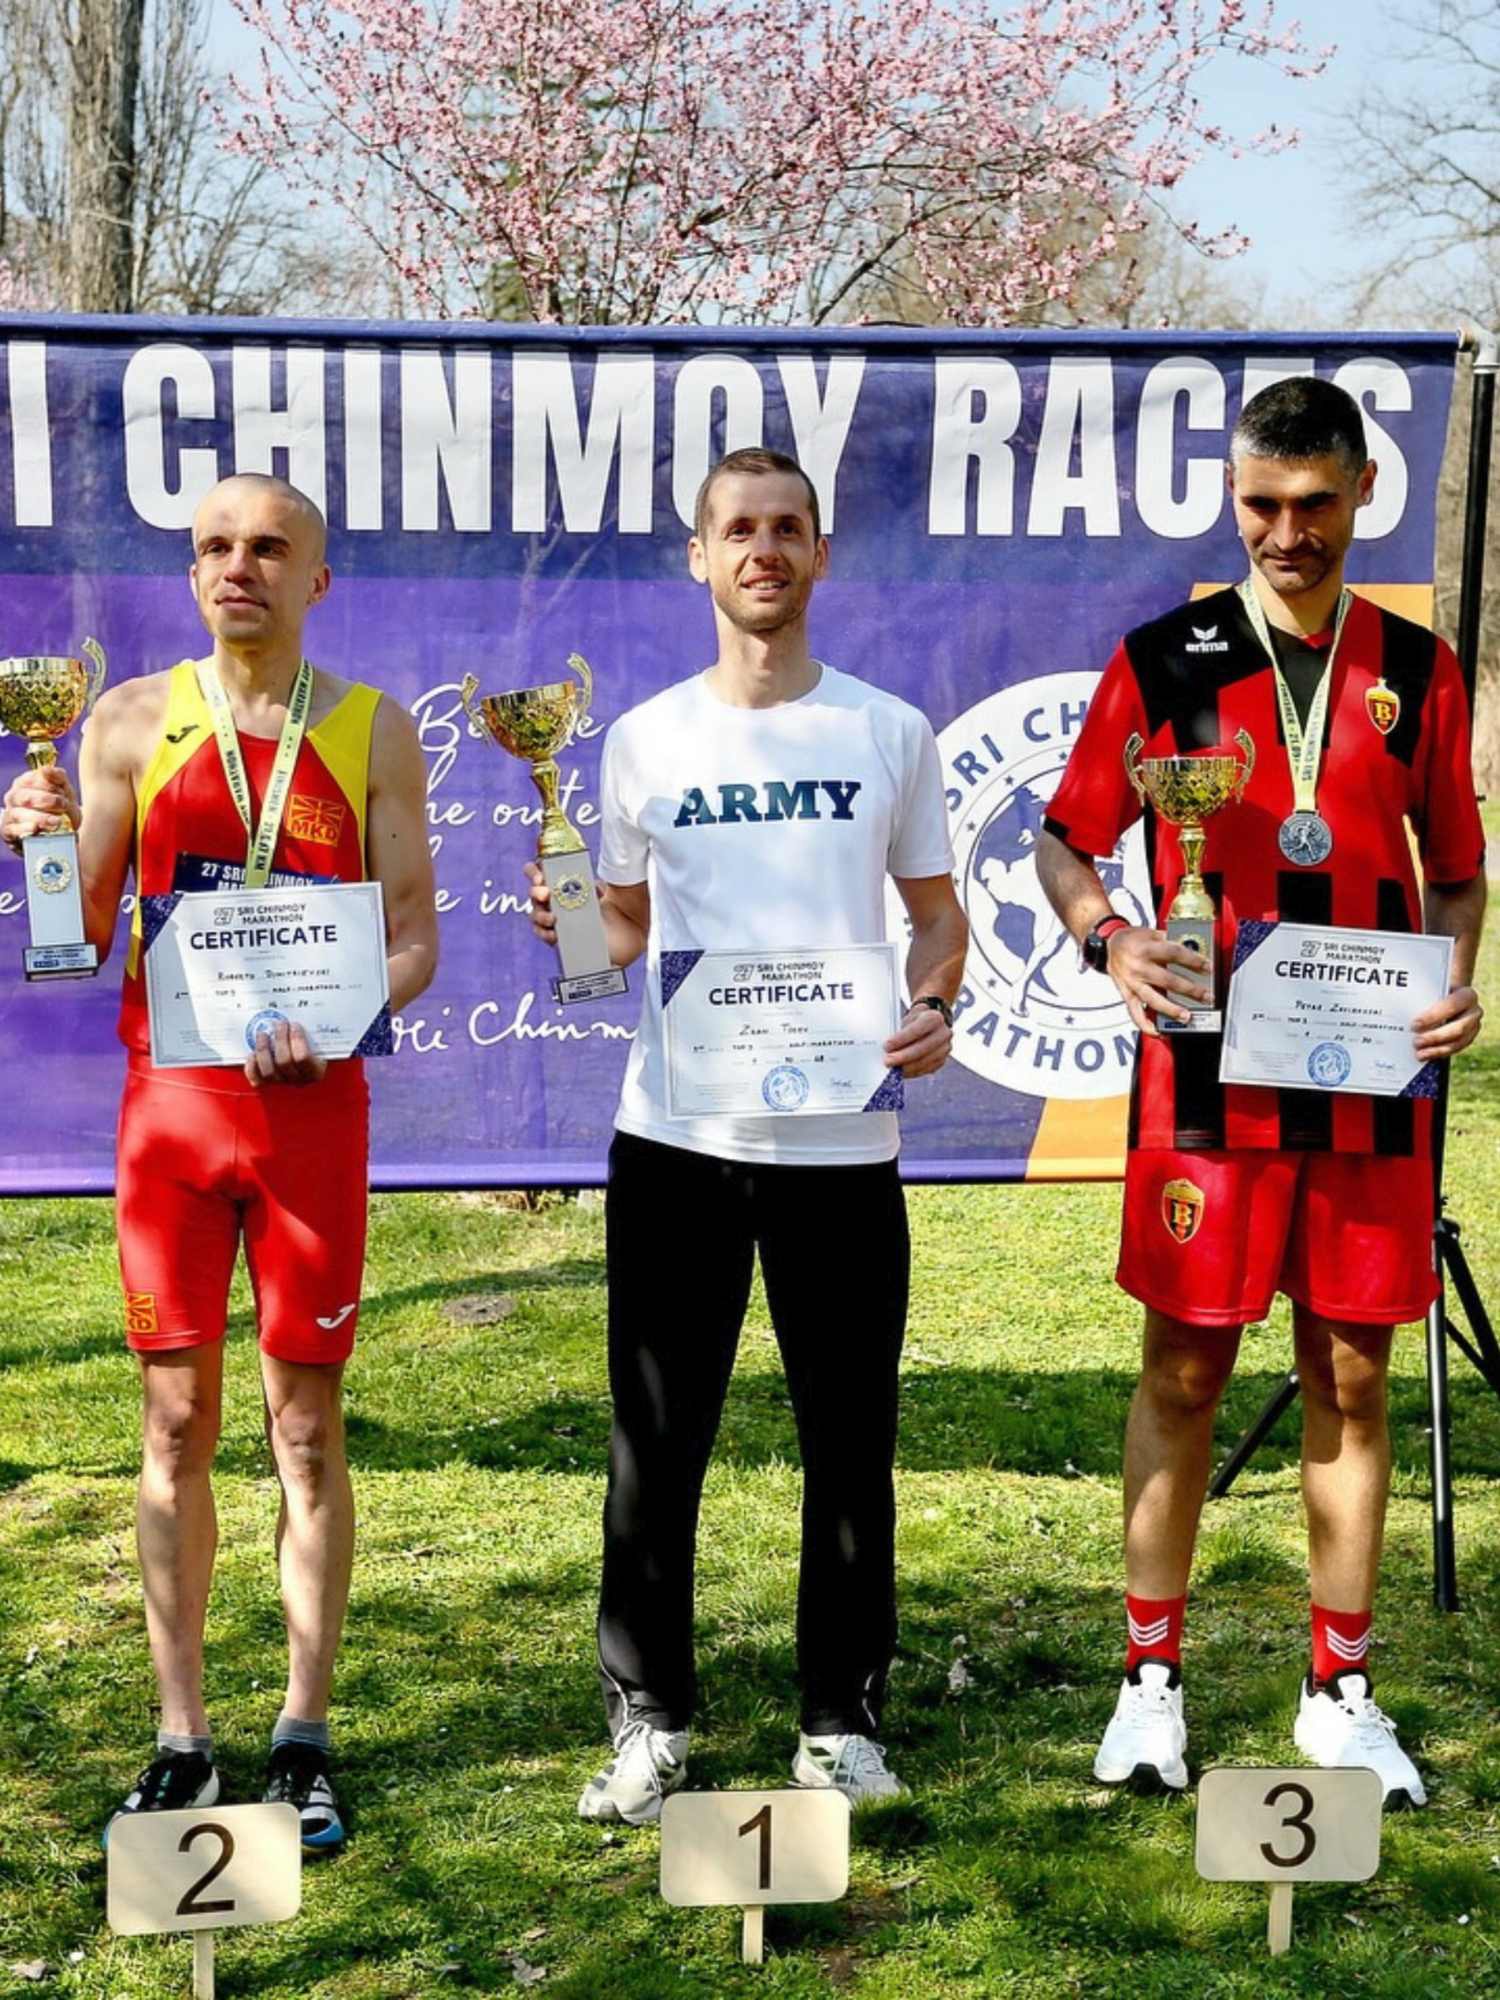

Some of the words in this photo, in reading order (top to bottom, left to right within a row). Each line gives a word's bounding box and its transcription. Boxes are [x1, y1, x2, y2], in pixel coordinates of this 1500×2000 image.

[121, 342, 867, 536] CHINMOY
[927, 355, 1412, 541] RACS
[1185, 641, 1229, 653] erima
[673, 780, 861, 828] ARMY
[292, 821, 338, 840] MKD
[237, 906, 254, 917] SRI
[257, 903, 306, 915] CHINMOY
[243, 914, 303, 925] MARATHON
[190, 925, 338, 950] CERTIFICATE
[1324, 942, 1339, 951] SRI
[1341, 943, 1386, 955] CHINMOY
[757, 963, 774, 973] SRI
[776, 961, 825, 972] CHINMOY
[1325, 952, 1382, 965] MARATHON
[761, 972, 822, 982] MARATHON
[1275, 961, 1409, 987] CERTIFICATE
[709, 982, 854, 1006] CERTIFICATE
[468, 992, 639, 1046] Chinm
[952, 984, 1139, 1073] RATHON
[1260, 1782, 1316, 1868] 3
[738, 1805, 772, 1889] 1
[176, 1824, 235, 1914] 2
